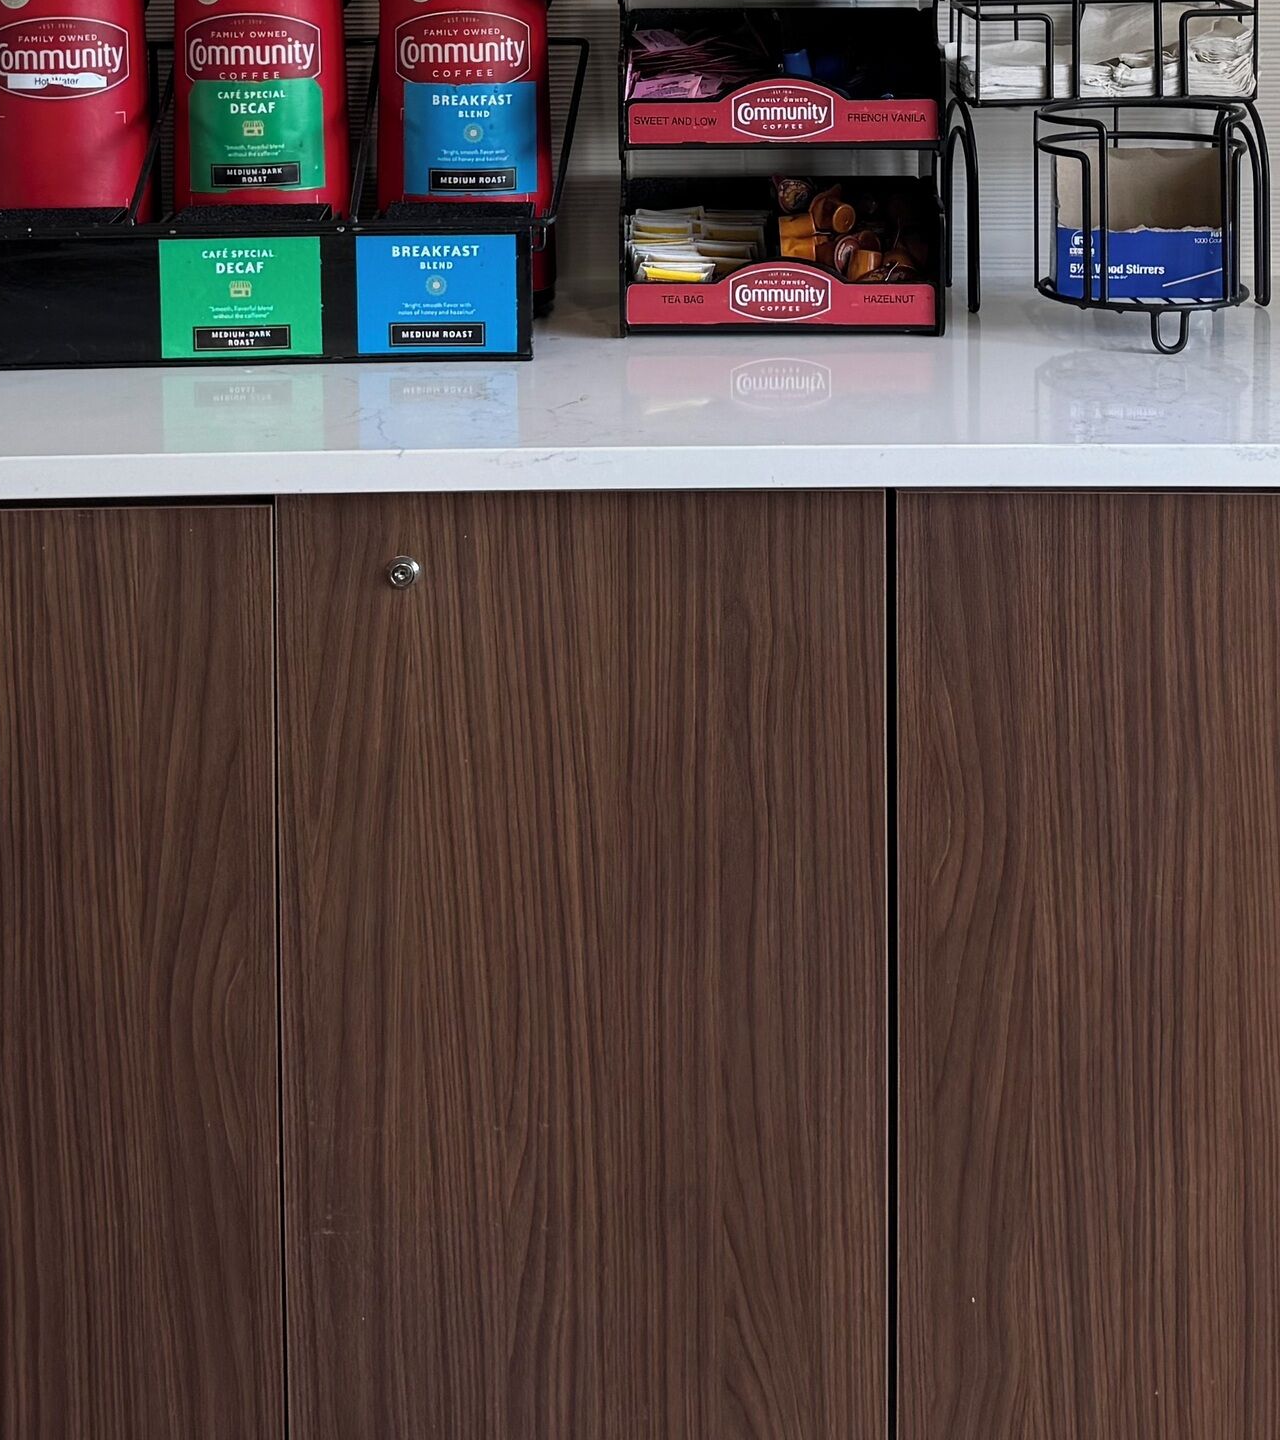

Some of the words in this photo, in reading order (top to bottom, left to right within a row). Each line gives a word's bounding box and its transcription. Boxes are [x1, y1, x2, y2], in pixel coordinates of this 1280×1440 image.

[249, 30, 287, 38] OWNED
[463, 28, 501, 36] OWNED
[18, 35, 55, 43] FAMILY
[59, 34, 98, 42] OWNED
[189, 37, 314, 71] Community
[400, 35, 525, 69] Community
[219, 71, 280, 80] COFFEE
[432, 69, 494, 78] COFFEE
[217, 89, 241, 99] CAFÉ
[244, 89, 286, 99] SPECIAL
[432, 94, 513, 106] BREAKFAST
[230, 102, 276, 114] DECAF
[458, 110, 490, 118] BLEND
[737, 101, 828, 125] Community
[633, 116, 669, 126] SWEET
[671, 116, 692, 126] AND
[694, 116, 717, 126] LOW
[847, 113, 889, 123] FRENCH
[890, 113, 927, 122] VANILA
[226, 168, 283, 176] MEDIUM-DARK
[440, 176, 476, 184] MEDIUM
[478, 175, 507, 184] ROAST
[202, 248, 228, 259] CAFÉ
[231, 249, 274, 258] SPECIAL
[391, 245, 480, 257] BREAKFAST
[215, 262, 264, 274] DECAF
[420, 261, 454, 270] BLEND
[1125, 263, 1165, 274] Stirrers
[661, 295, 681, 304] TEA
[683, 295, 704, 304] BAG
[735, 284, 826, 306] Community
[863, 295, 915, 304] HAZELNUT
[211, 330, 271, 338] MEDIUM-DARK
[401, 331, 440, 339] MEDIUM
[442, 330, 473, 339] ROAST
